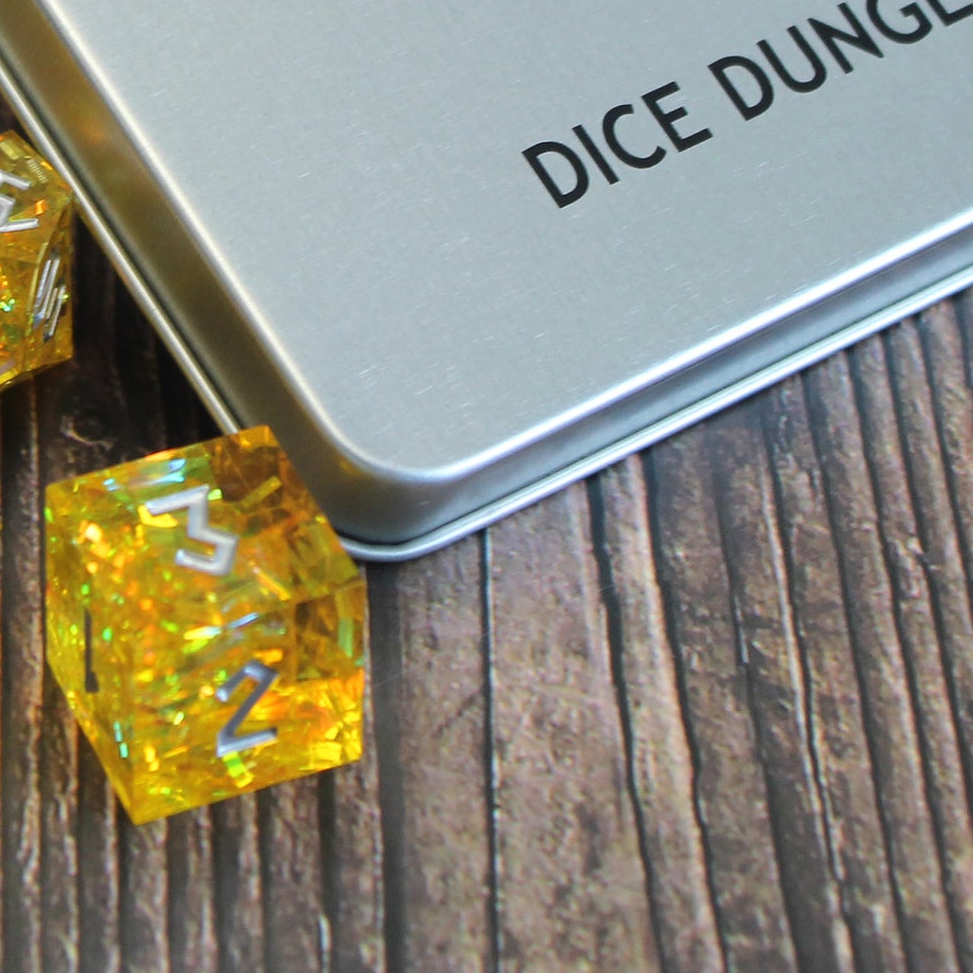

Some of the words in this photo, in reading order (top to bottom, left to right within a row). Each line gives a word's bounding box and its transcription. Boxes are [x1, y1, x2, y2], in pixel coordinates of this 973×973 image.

[522, 81, 714, 209] DICE
[145, 485, 239, 576] 3
[215, 659, 278, 758] 2
